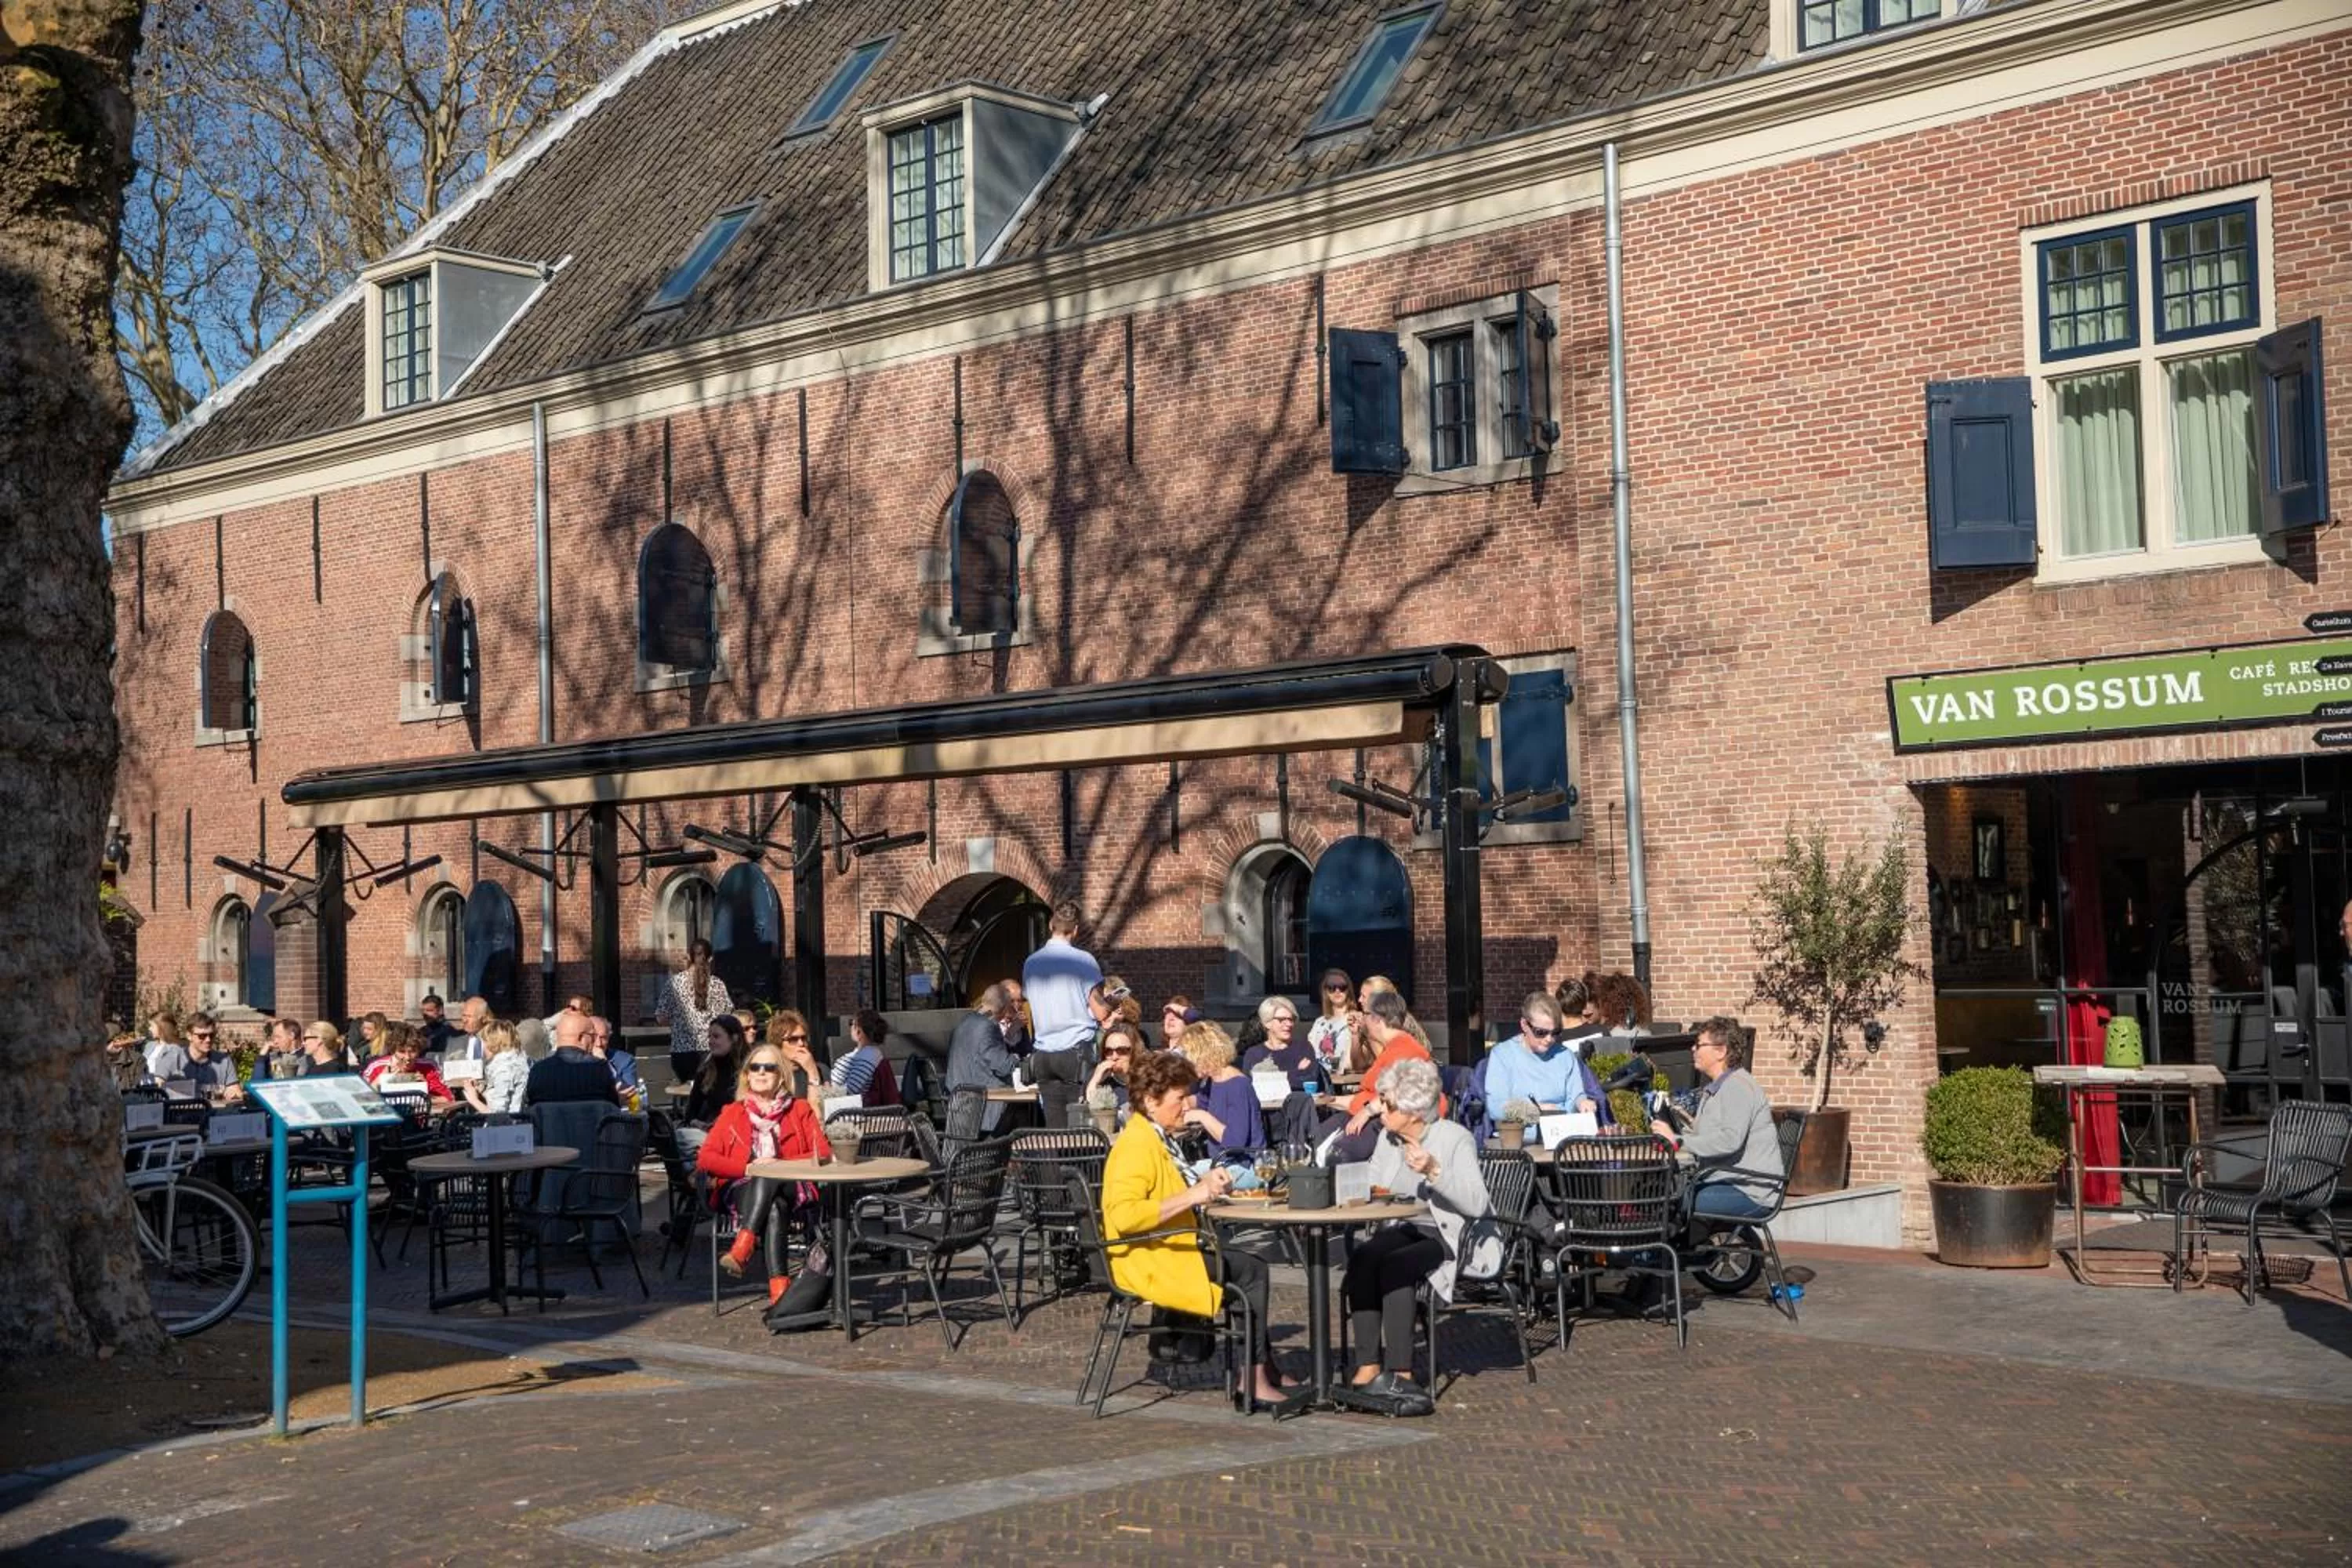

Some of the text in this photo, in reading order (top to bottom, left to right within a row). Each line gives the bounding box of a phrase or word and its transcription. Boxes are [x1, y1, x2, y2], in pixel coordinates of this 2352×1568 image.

[2230, 660, 2276, 680] CAFÉ
[2263, 677, 2352, 696] STADSHO
[1910, 671, 2204, 724] VAN ROSSUM
[2162, 982, 2200, 996] VAN
[2162, 999, 2242, 1016] ROSSUM
